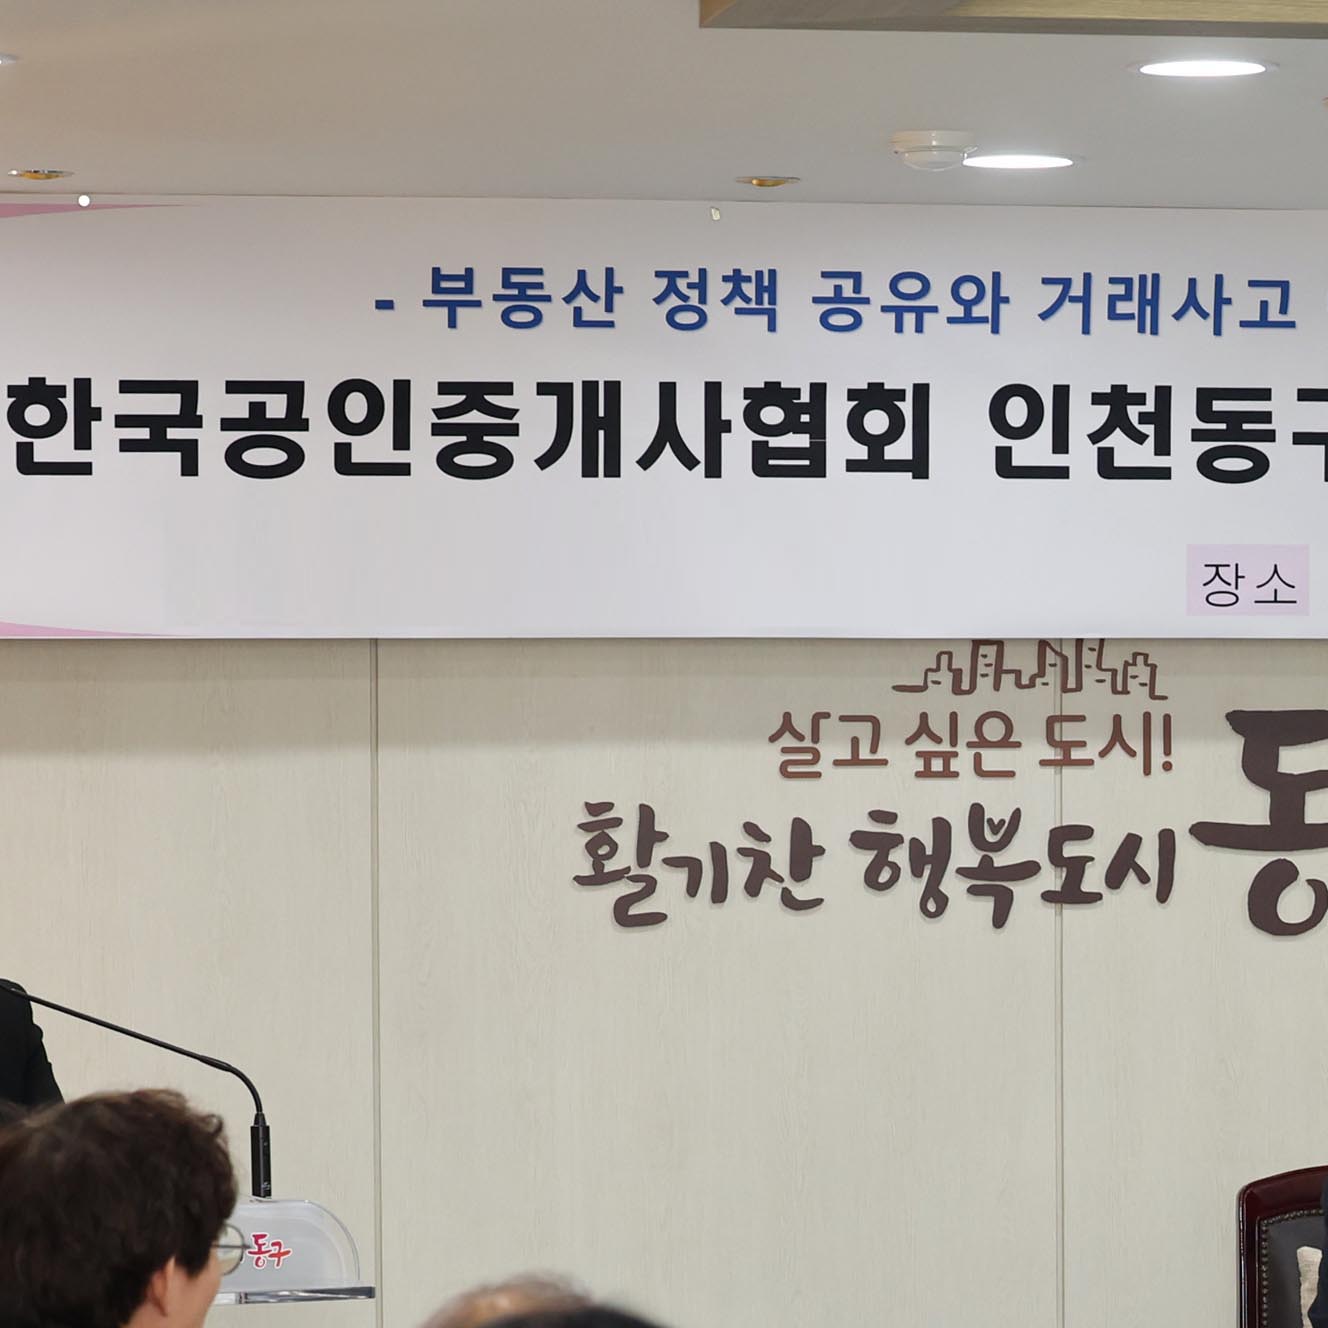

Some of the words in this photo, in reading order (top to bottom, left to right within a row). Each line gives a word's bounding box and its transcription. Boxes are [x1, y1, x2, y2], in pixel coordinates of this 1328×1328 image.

[422, 266, 625, 330] 부동산
[652, 267, 778, 334] 정책
[811, 270, 1010, 336] 공유와
[1037, 271, 1297, 338] 거래사고
[6, 376, 931, 481] 한국공인중개사협회
[1202, 561, 1299, 608] 장소
[768, 711, 888, 779] 살고
[905, 711, 1022, 779] 싶은
[1039, 711, 1173, 777] 도시!
[573, 802, 827, 928] 활기찬
[849, 803, 1176, 930] 행복도시
[247, 1233, 292, 1269] 동구
